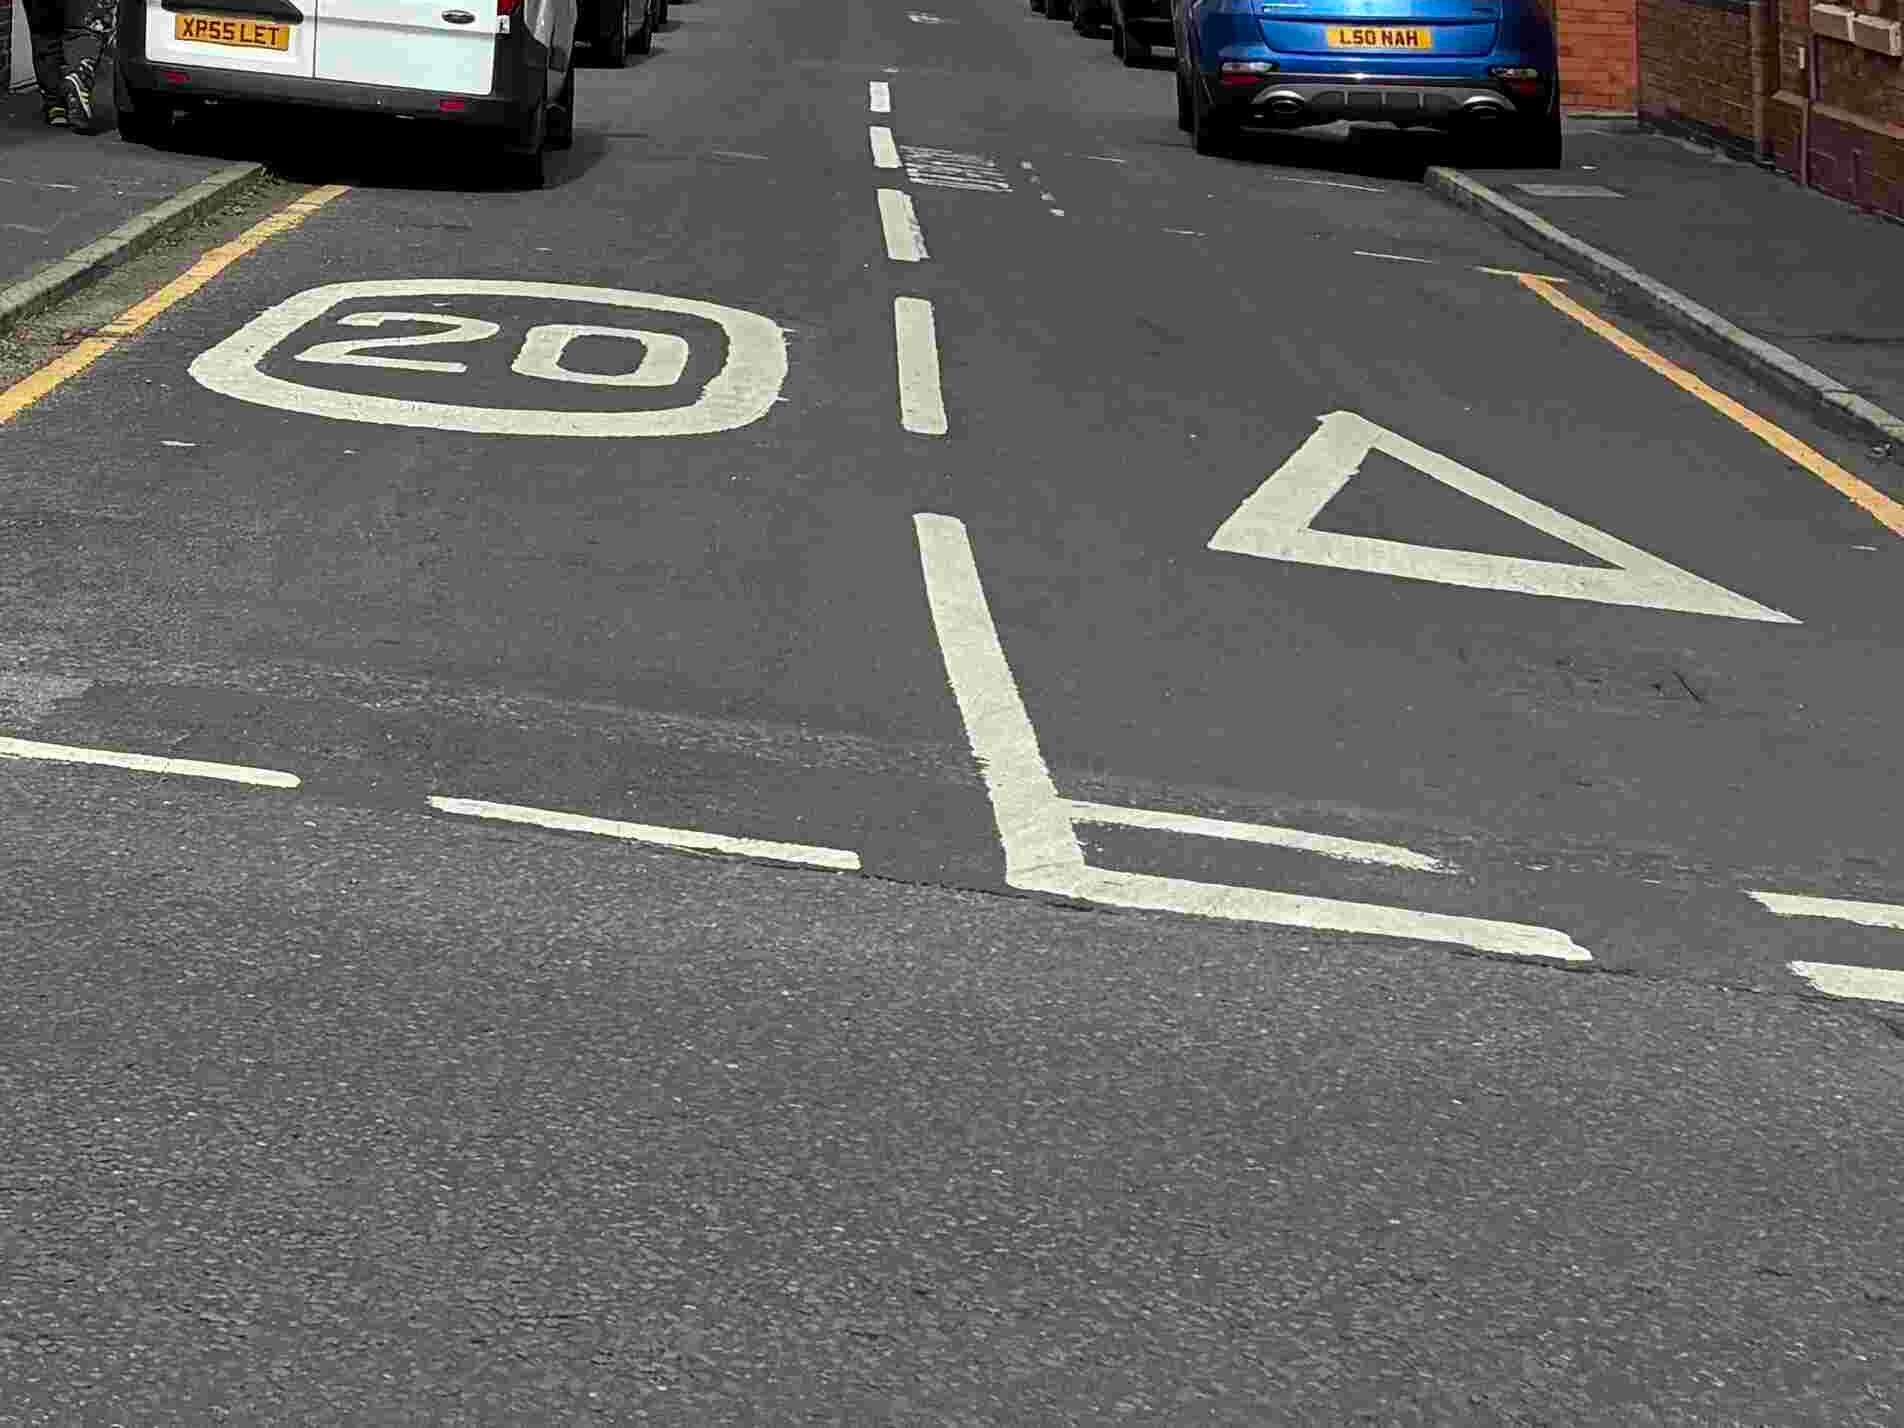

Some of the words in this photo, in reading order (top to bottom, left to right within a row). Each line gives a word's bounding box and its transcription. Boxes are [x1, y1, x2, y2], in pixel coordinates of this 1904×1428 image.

[183, 17, 236, 41] XP55
[240, 23, 280, 45] LET
[1381, 29, 1419, 47] NAH
[294, 310, 690, 386] 20
